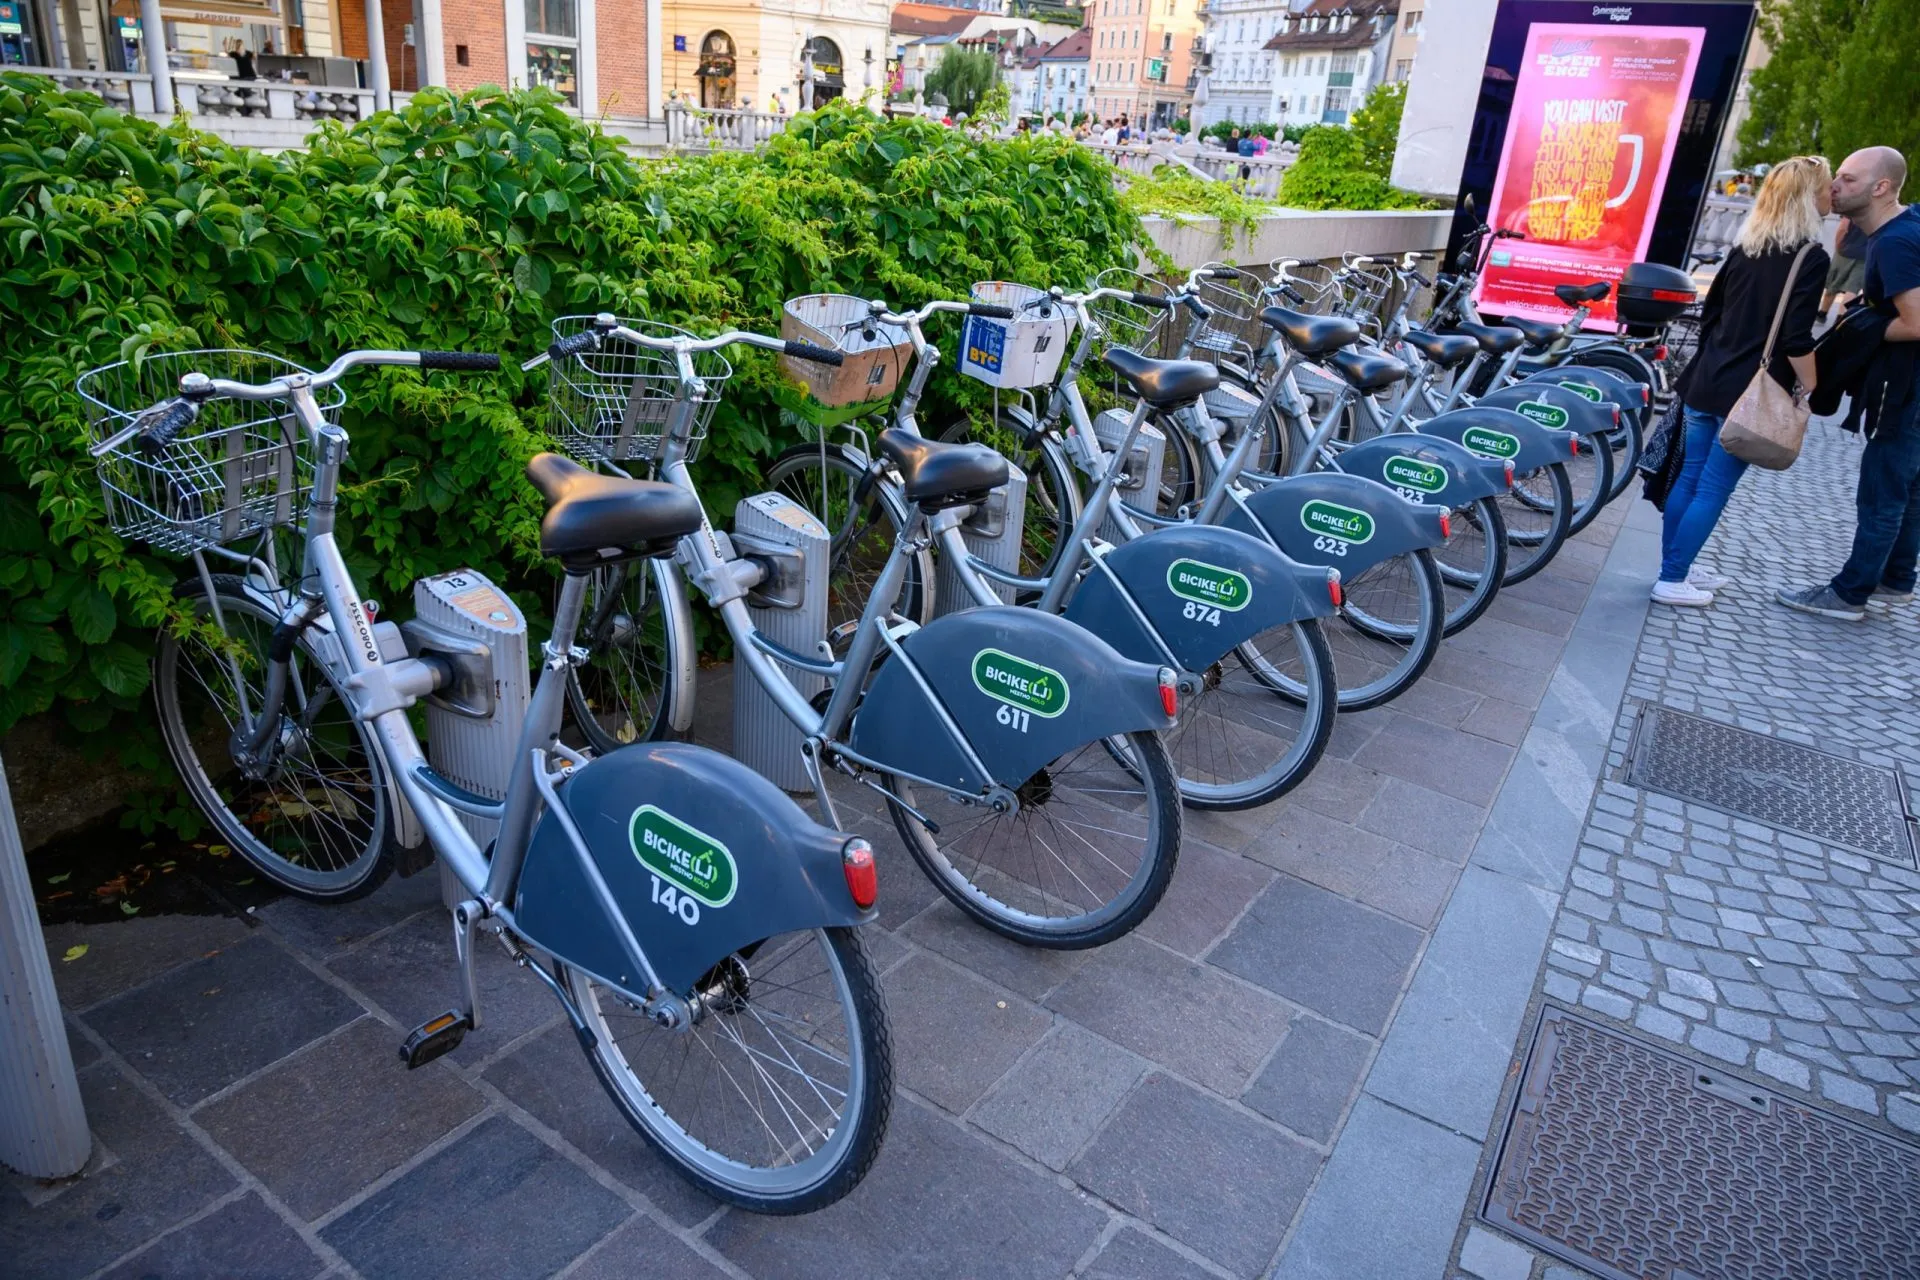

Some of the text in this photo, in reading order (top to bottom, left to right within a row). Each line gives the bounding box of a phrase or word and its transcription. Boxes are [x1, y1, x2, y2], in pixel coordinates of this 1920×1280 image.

[1544, 100, 1628, 123] YOU CAN VISIT
[1540, 122, 1622, 144] A TOURIST
[1536, 142, 1619, 162] ATTRACTION
[1585, 162, 1615, 183] GRAB
[969, 346, 998, 369] BTC
[761, 498, 779, 508] 14
[1396, 486, 1425, 504] 823
[1314, 536, 1350, 557] 623
[444, 577, 468, 589] 13
[1182, 601, 1221, 627] 874
[360, 628, 372, 649] 080
[996, 704, 1030, 734] 611
[670, 862, 694, 880] MESTNO
[650, 874, 700, 926] 140
